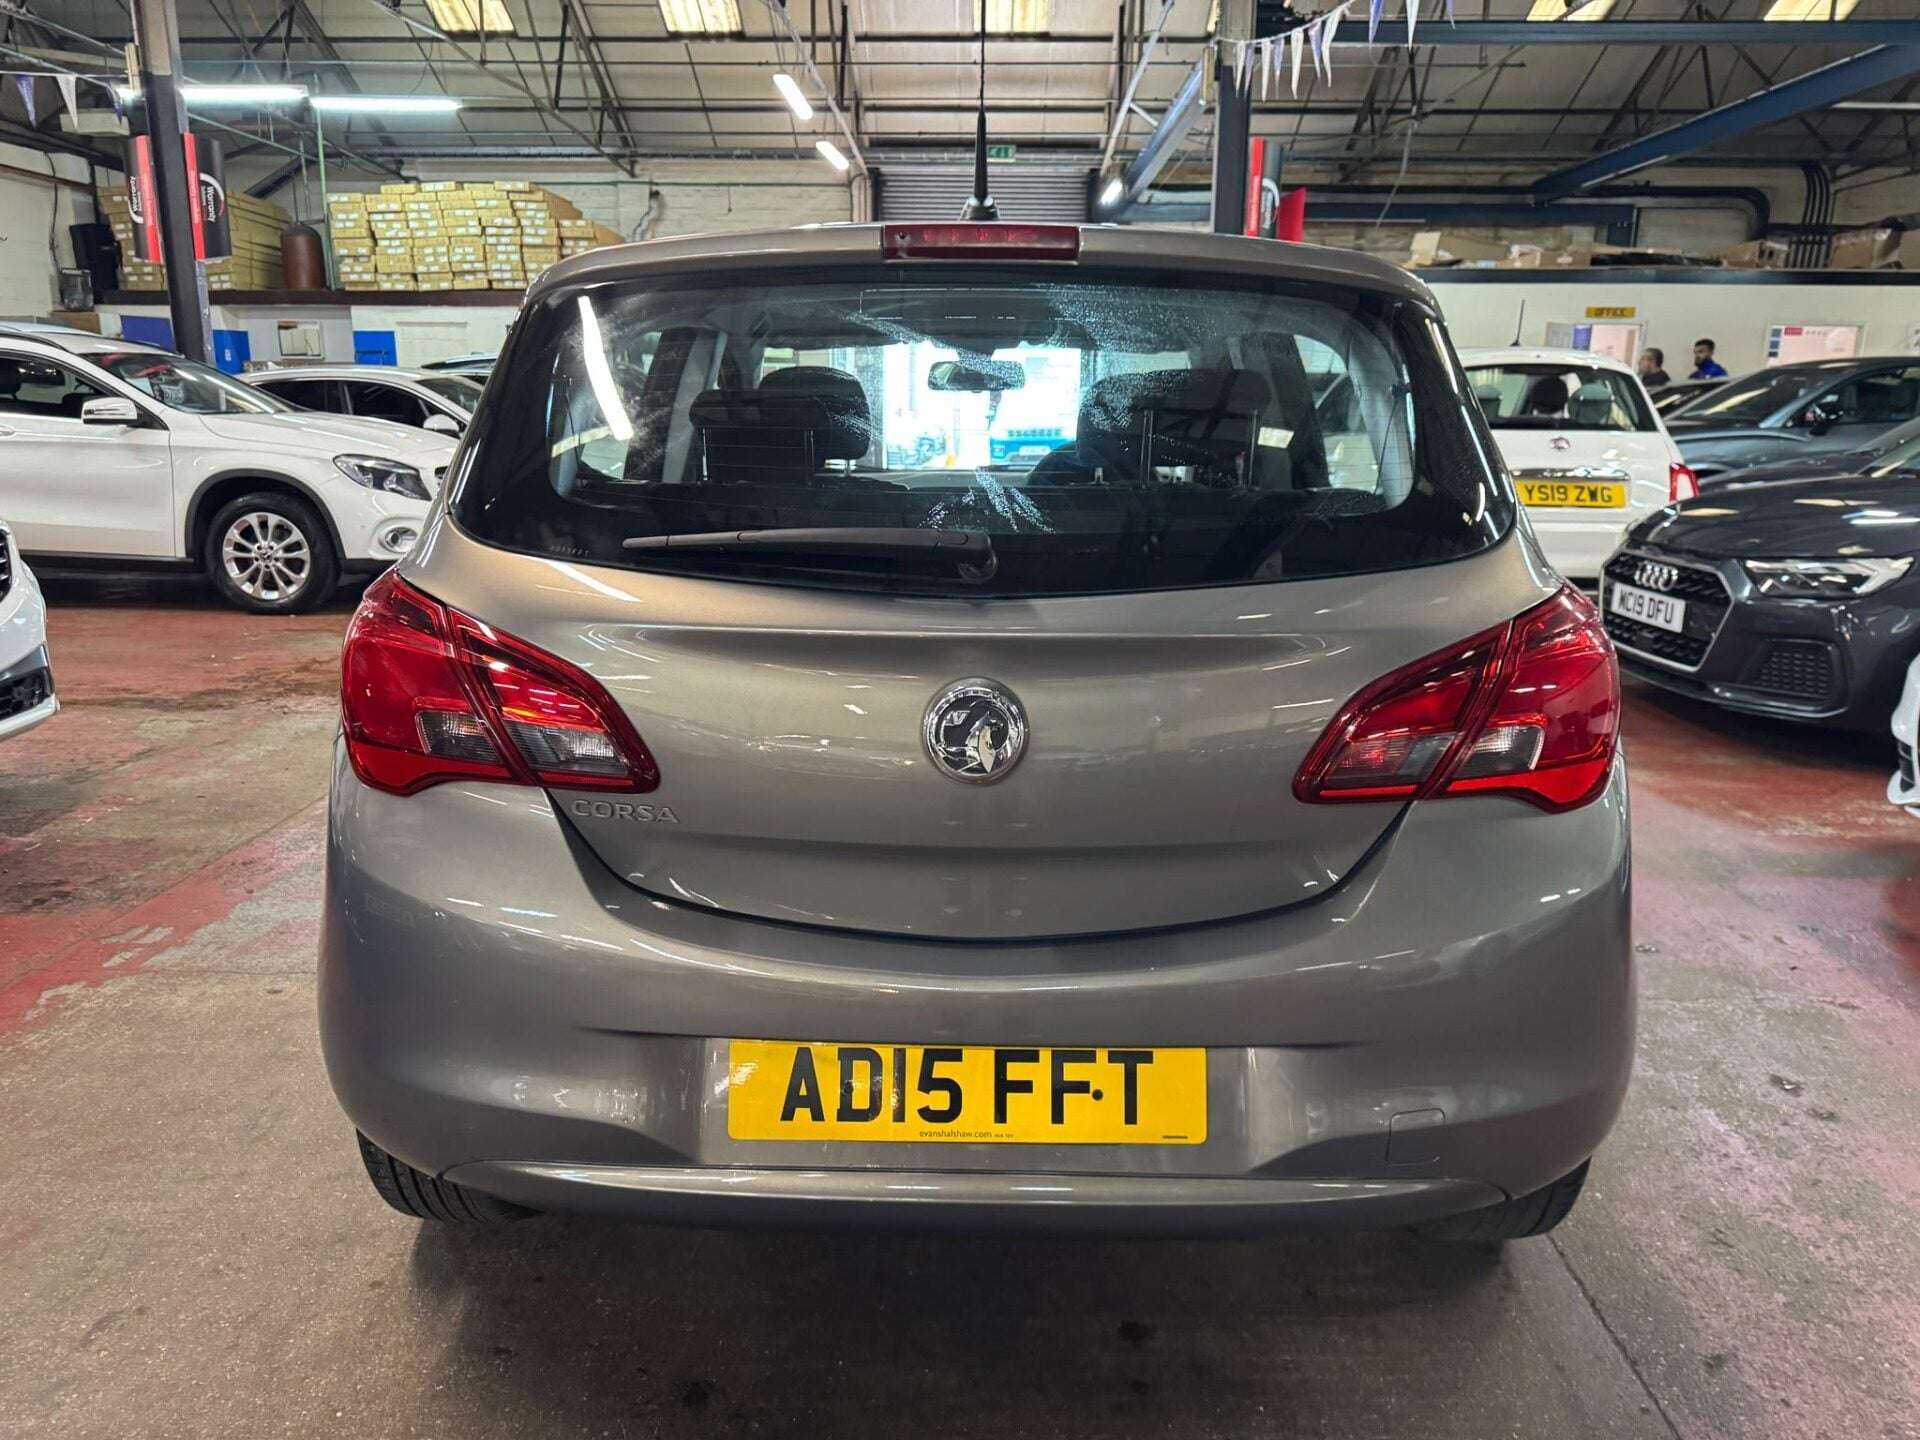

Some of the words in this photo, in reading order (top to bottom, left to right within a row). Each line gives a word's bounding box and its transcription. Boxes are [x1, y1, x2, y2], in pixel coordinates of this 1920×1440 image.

[207, 187, 217, 222] Warranty
[1524, 484, 1568, 502] YS19
[1574, 486, 1612, 503] ZWG
[1647, 597, 1674, 624] DFU
[572, 800, 680, 824] CORSA
[780, 1047, 964, 1123] AD15
[993, 1049, 1155, 1126] FFT
[919, 1128, 992, 1139] evanshalshaw.com
